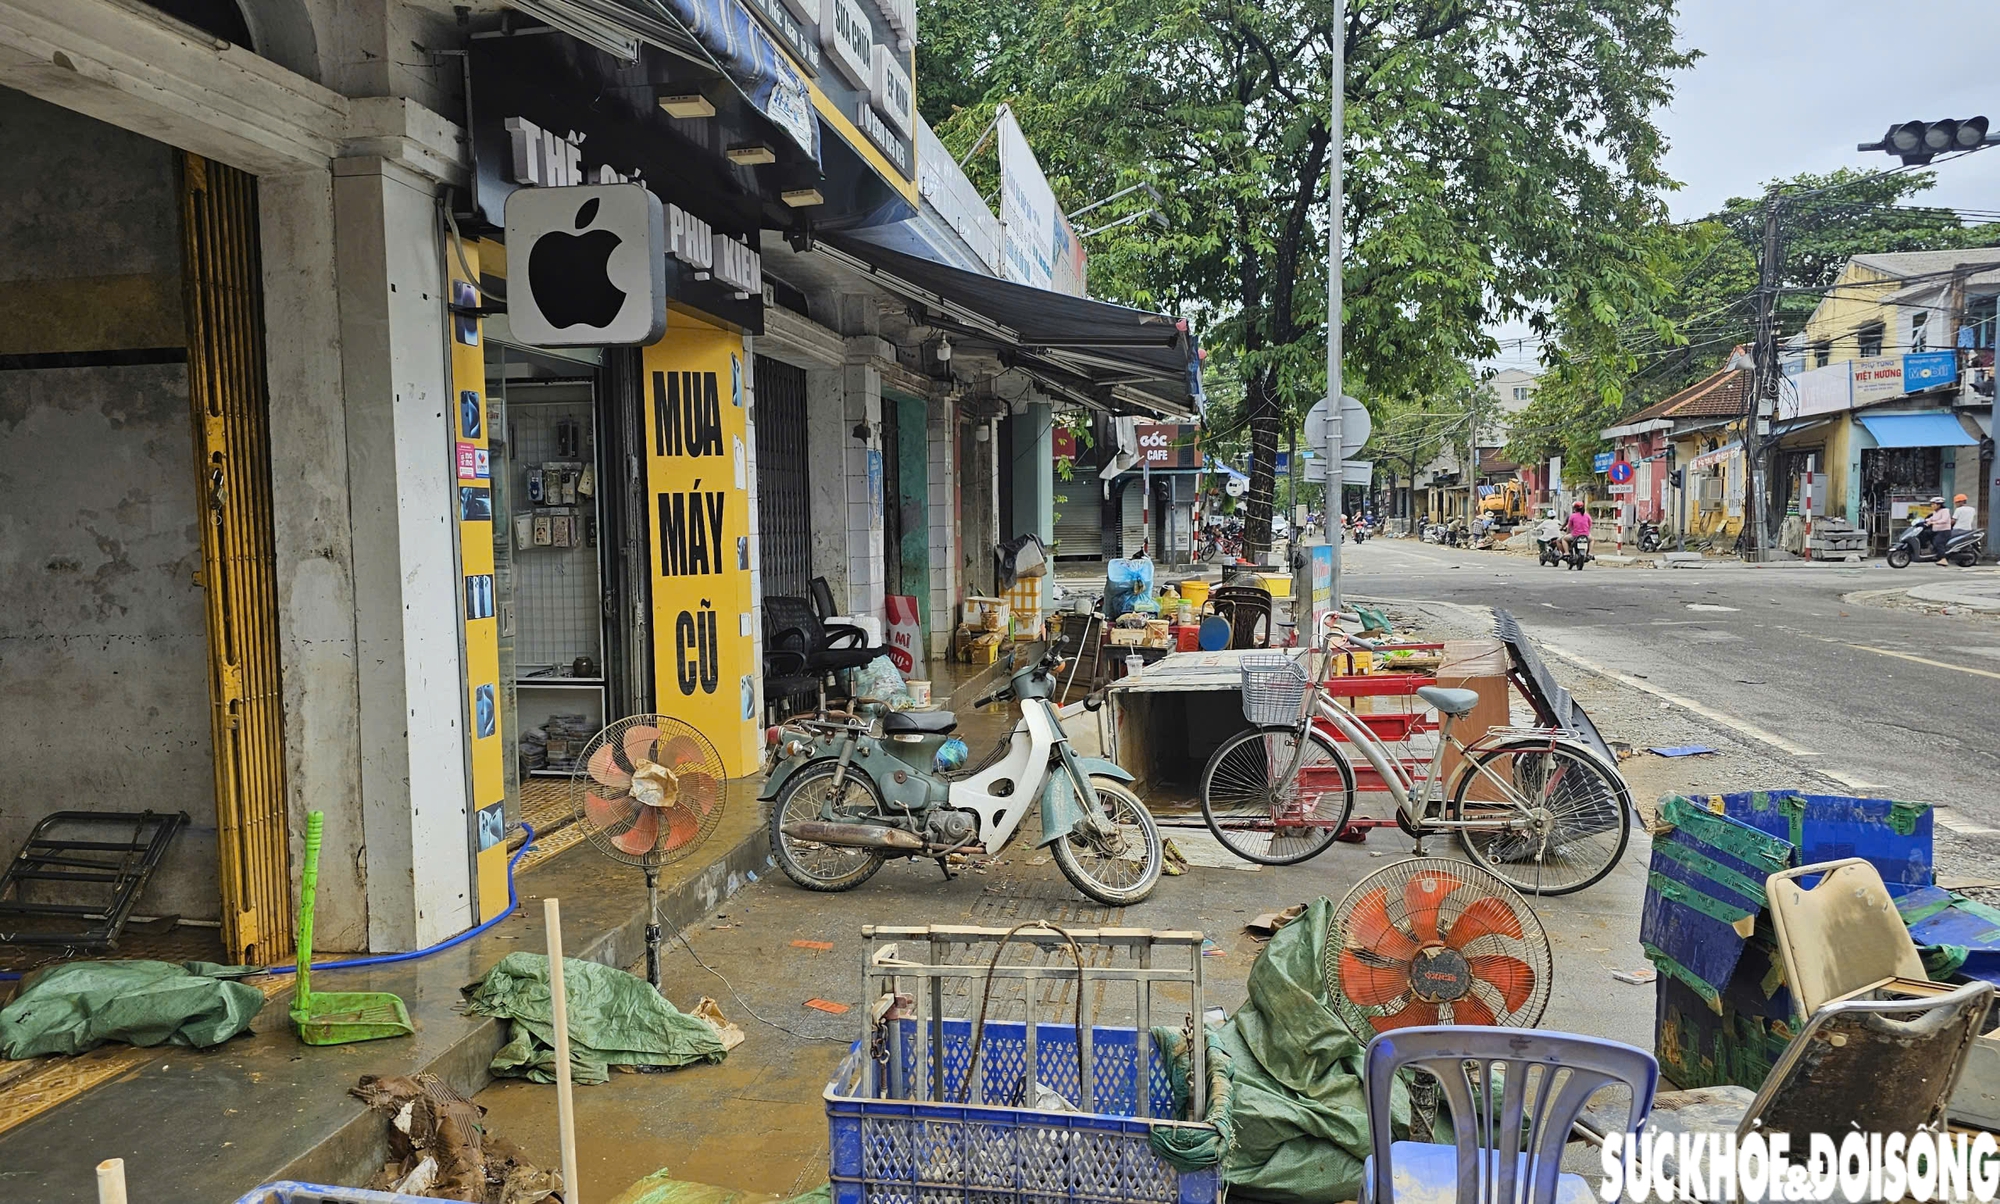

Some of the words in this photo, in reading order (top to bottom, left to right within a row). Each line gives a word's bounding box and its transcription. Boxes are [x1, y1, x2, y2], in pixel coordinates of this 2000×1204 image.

[507, 116, 588, 188] THẾ
[668, 202, 713, 282] PHỤ
[717, 232, 762, 300] KIỆN
[1855, 370, 1872, 382] VIỆT
[1908, 364, 1949, 380] Mobil
[652, 371, 724, 458] MUA
[1139, 430, 1168, 447] GỐC
[1146, 449, 1168, 461] CAFE
[658, 478, 725, 578] MÁY
[675, 597, 718, 696] CŨ
